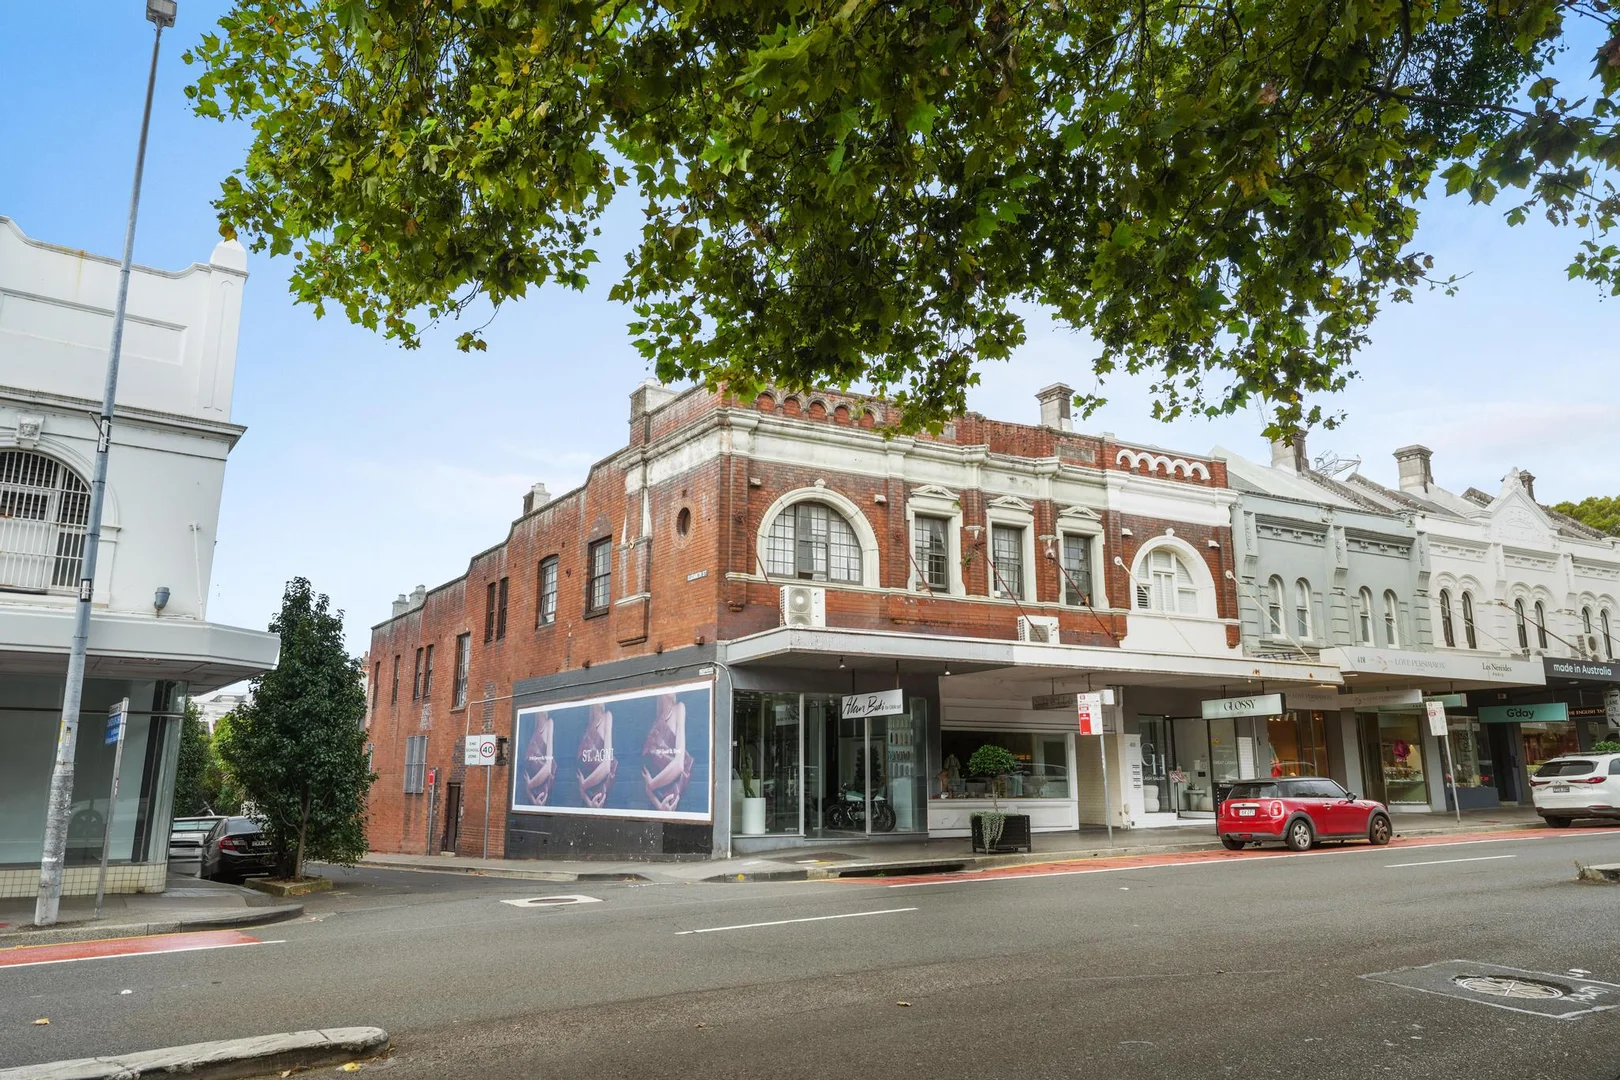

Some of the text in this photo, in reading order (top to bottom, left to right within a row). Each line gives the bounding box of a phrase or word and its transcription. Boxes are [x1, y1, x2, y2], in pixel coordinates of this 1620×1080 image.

[1553, 663, 1612, 676] made in Australia
[1223, 699, 1255, 711] GLOSSY
[1506, 708, 1535, 719] G'day
[482, 746, 493, 754] 40
[582, 747, 614, 762] ST. AGNI
